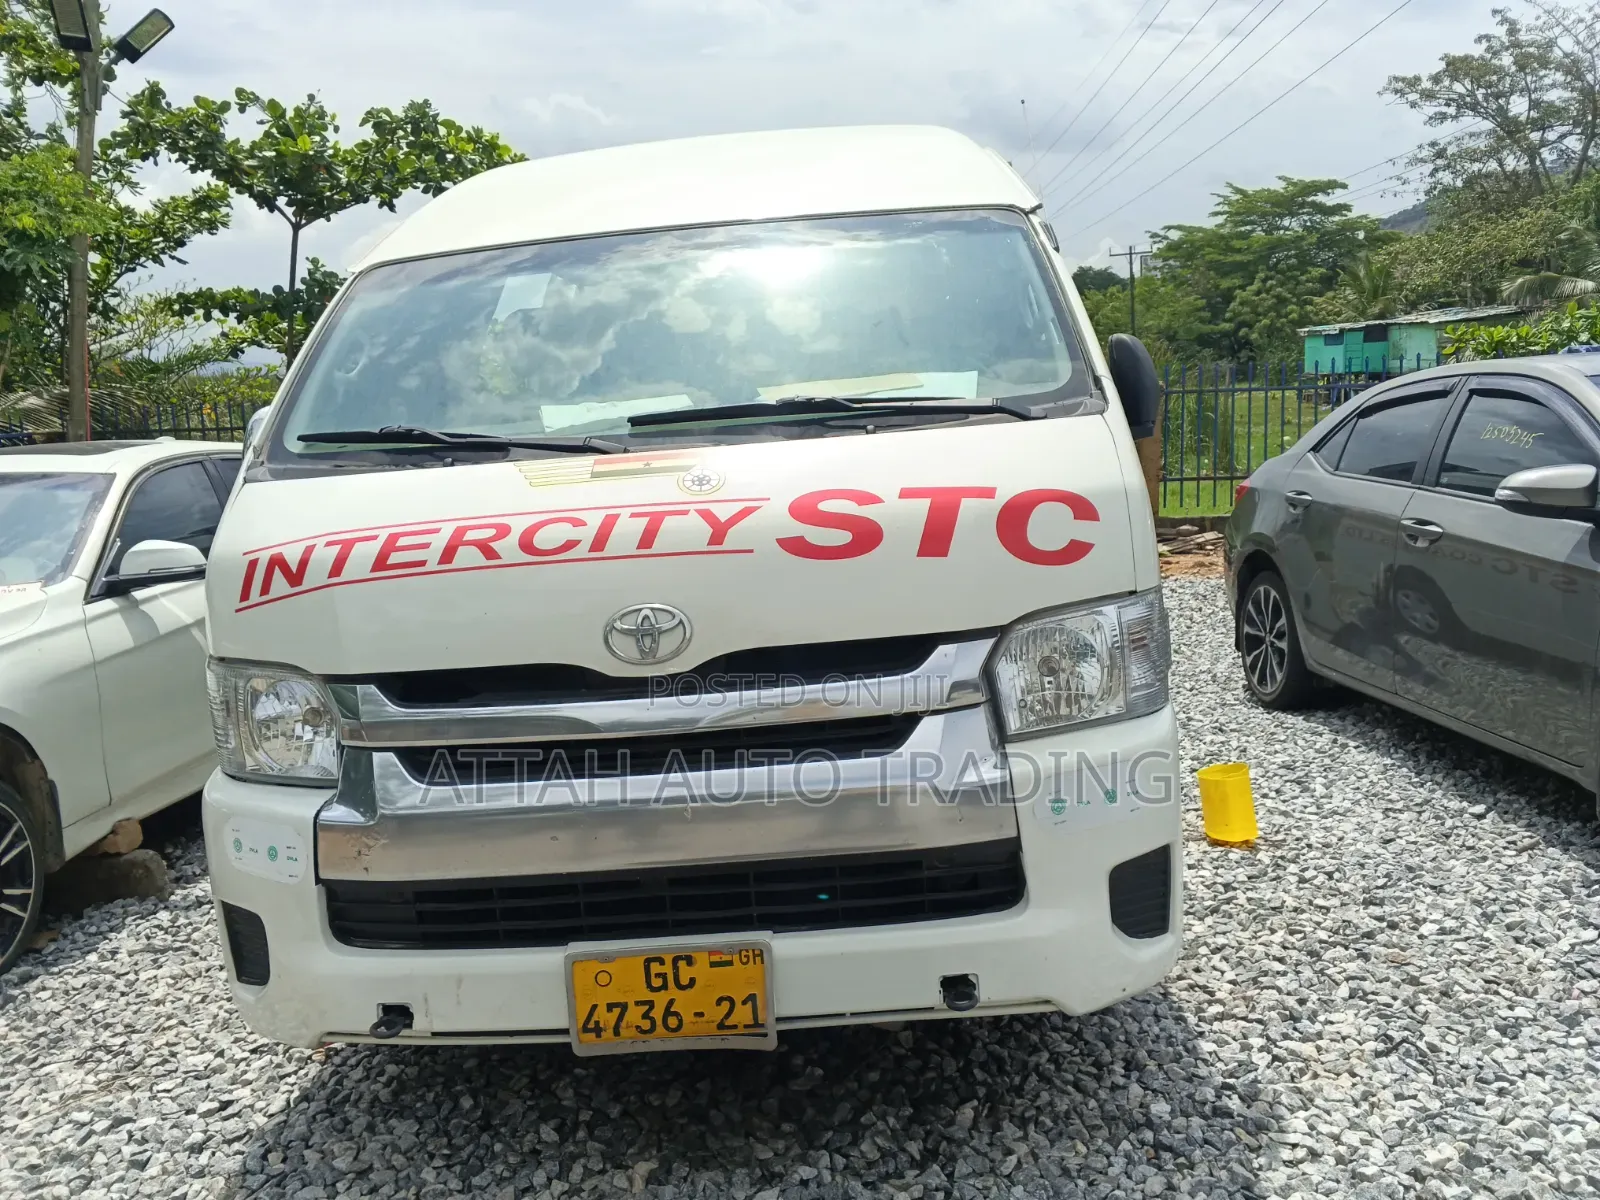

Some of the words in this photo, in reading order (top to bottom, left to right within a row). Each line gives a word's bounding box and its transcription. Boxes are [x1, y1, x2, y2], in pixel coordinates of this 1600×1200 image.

[238, 505, 765, 604] INTERCITY
[775, 486, 1101, 566] STC
[643, 954, 697, 993] GC
[738, 948, 765, 966] GH
[581, 993, 766, 1039] 4736-21
